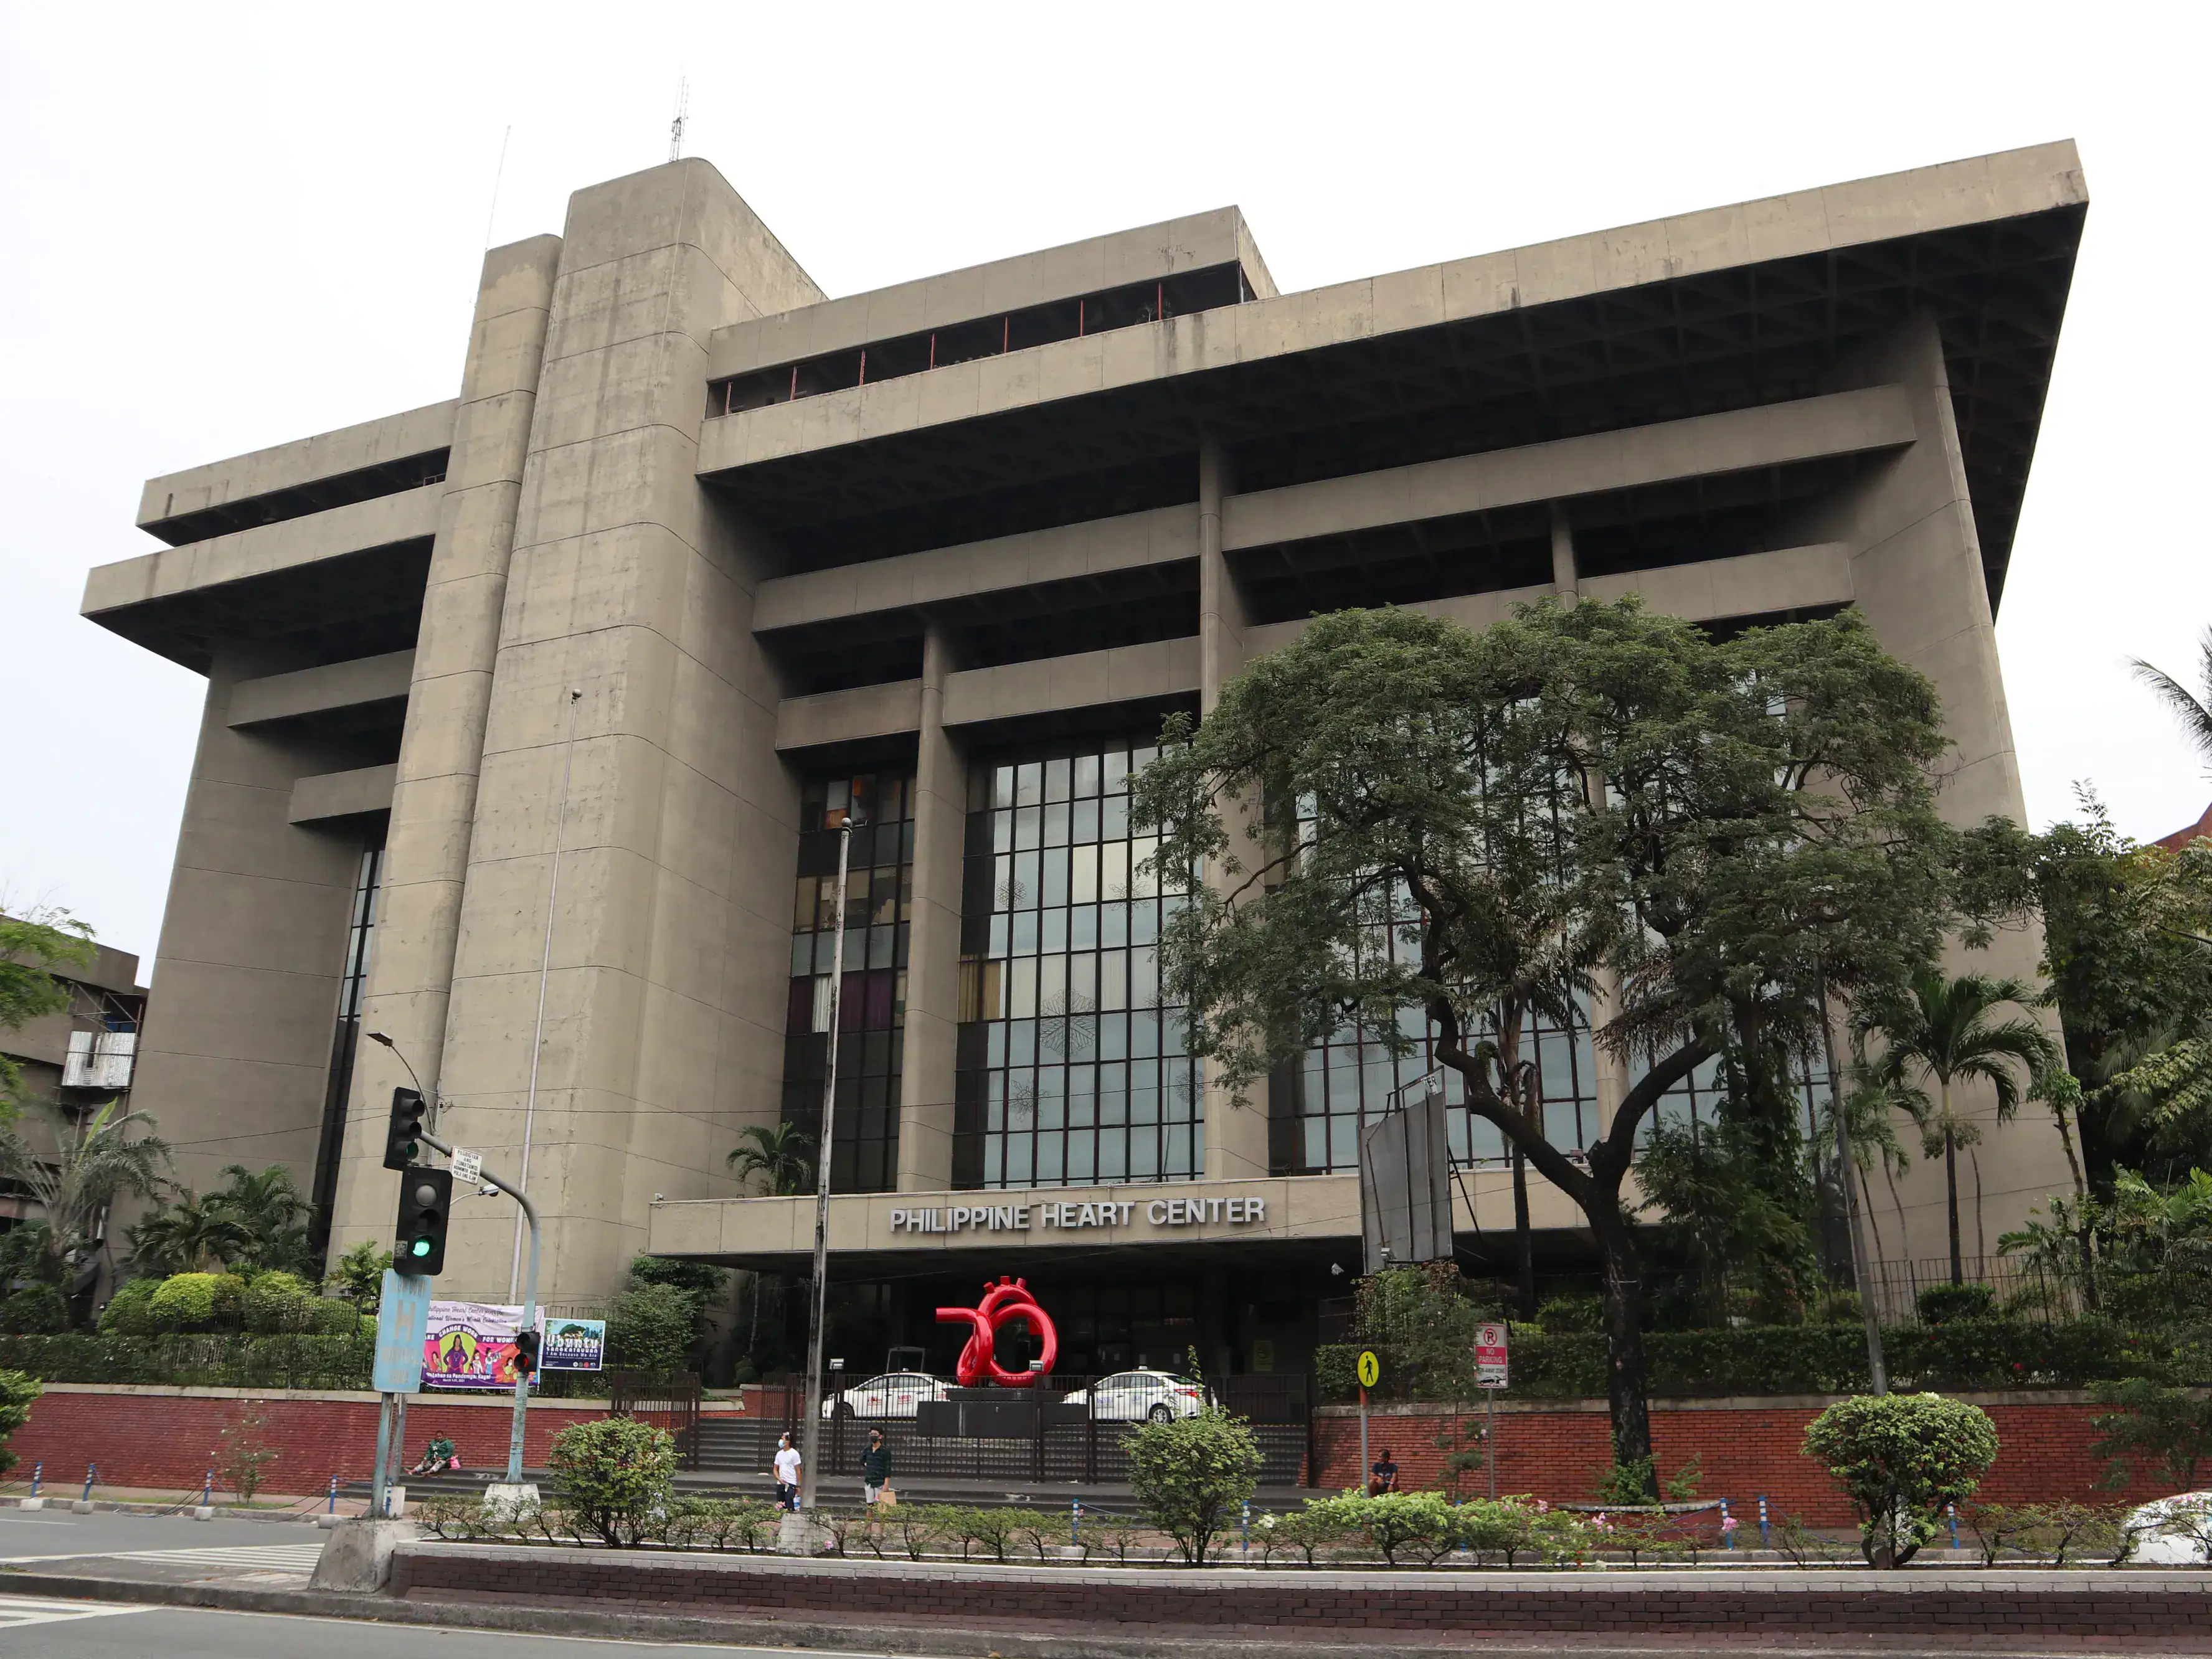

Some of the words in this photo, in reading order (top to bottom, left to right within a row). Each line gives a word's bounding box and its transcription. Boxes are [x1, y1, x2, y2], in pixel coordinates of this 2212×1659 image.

[458, 1150, 478, 1160] PAGBIGYAN
[890, 1205, 1030, 1232] PHILIPPINE
[1041, 1201, 1135, 1227] HEART
[1147, 1197, 1265, 1225] CENTER
[428, 1306, 450, 1315] hilippine
[395, 1299, 416, 1342] H
[438, 1325, 461, 1338] CHANGE
[463, 1326, 478, 1338] WORK
[547, 1334, 598, 1349] Ubuntu
